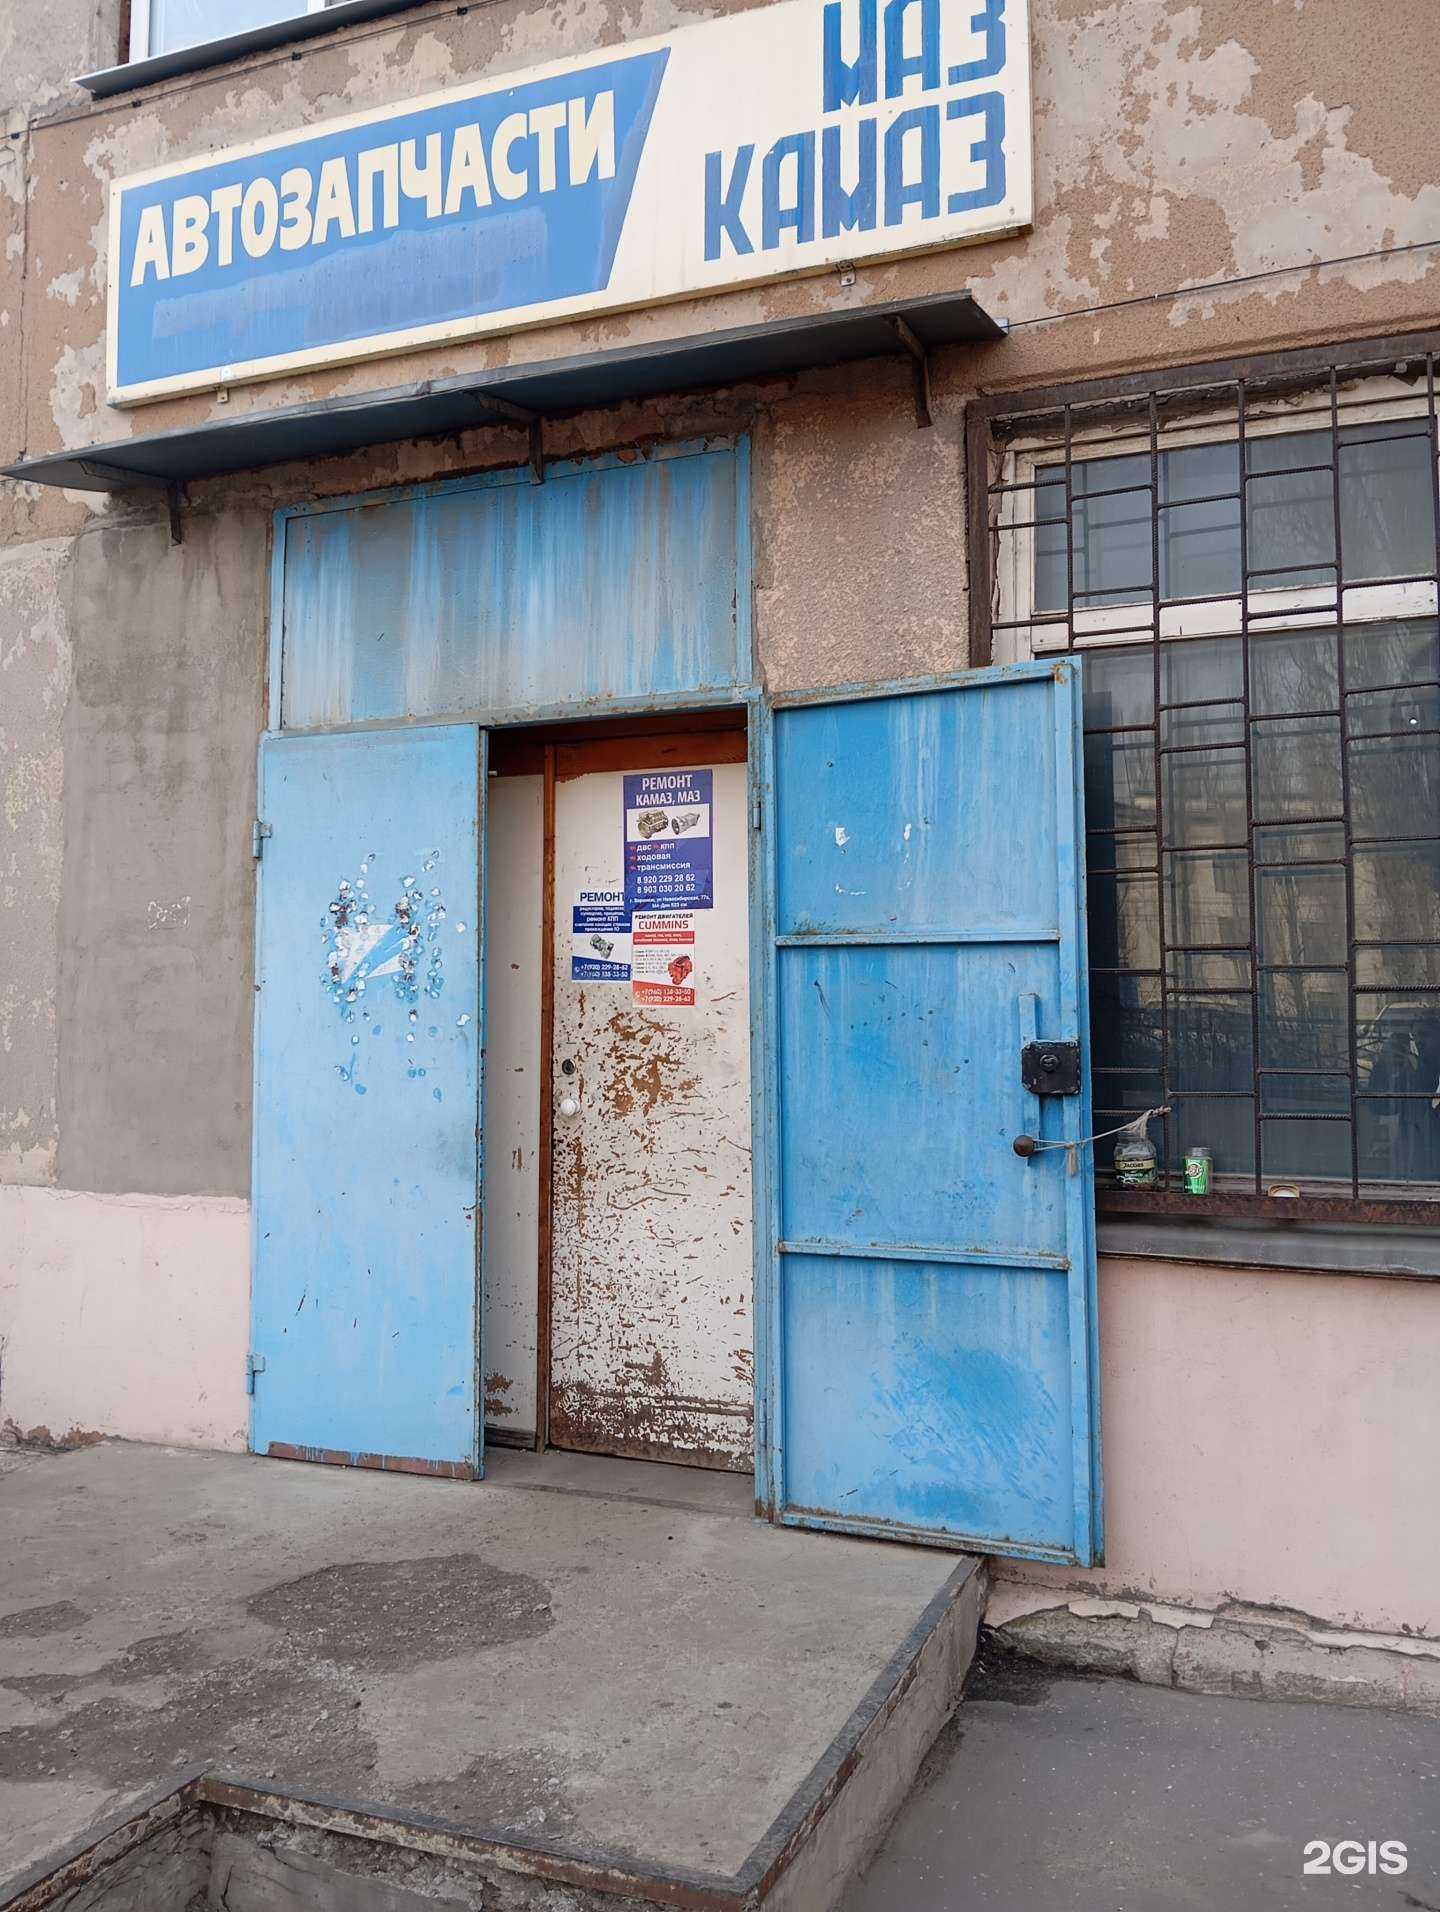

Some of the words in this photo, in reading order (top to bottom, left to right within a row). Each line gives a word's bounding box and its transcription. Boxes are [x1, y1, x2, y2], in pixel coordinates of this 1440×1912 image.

[823, 0, 1006, 113] МАЗ
[704, 91, 1006, 262] КАМАЗ
[130, 90, 616, 288] АВТОЗАПЧАСТИ
[642, 774, 693, 791] РЕМОНТ
[636, 792, 675, 806] КАМАЗ,
[677, 790, 701, 803] МАЗ
[637, 853, 671, 862] ходовая
[637, 862, 691, 873] трансмиссия
[643, 875, 657, 884] 920
[659, 874, 673, 883] 229
[674, 874, 684, 882] 28
[685, 873, 696, 881] 62
[637, 886, 642, 894] 8
[643, 885, 657, 894] 903
[659, 885, 673, 893] 030
[674, 884, 684, 892] 20
[685, 883, 696, 891] 62
[638, 919, 689, 930] CUMMINS
